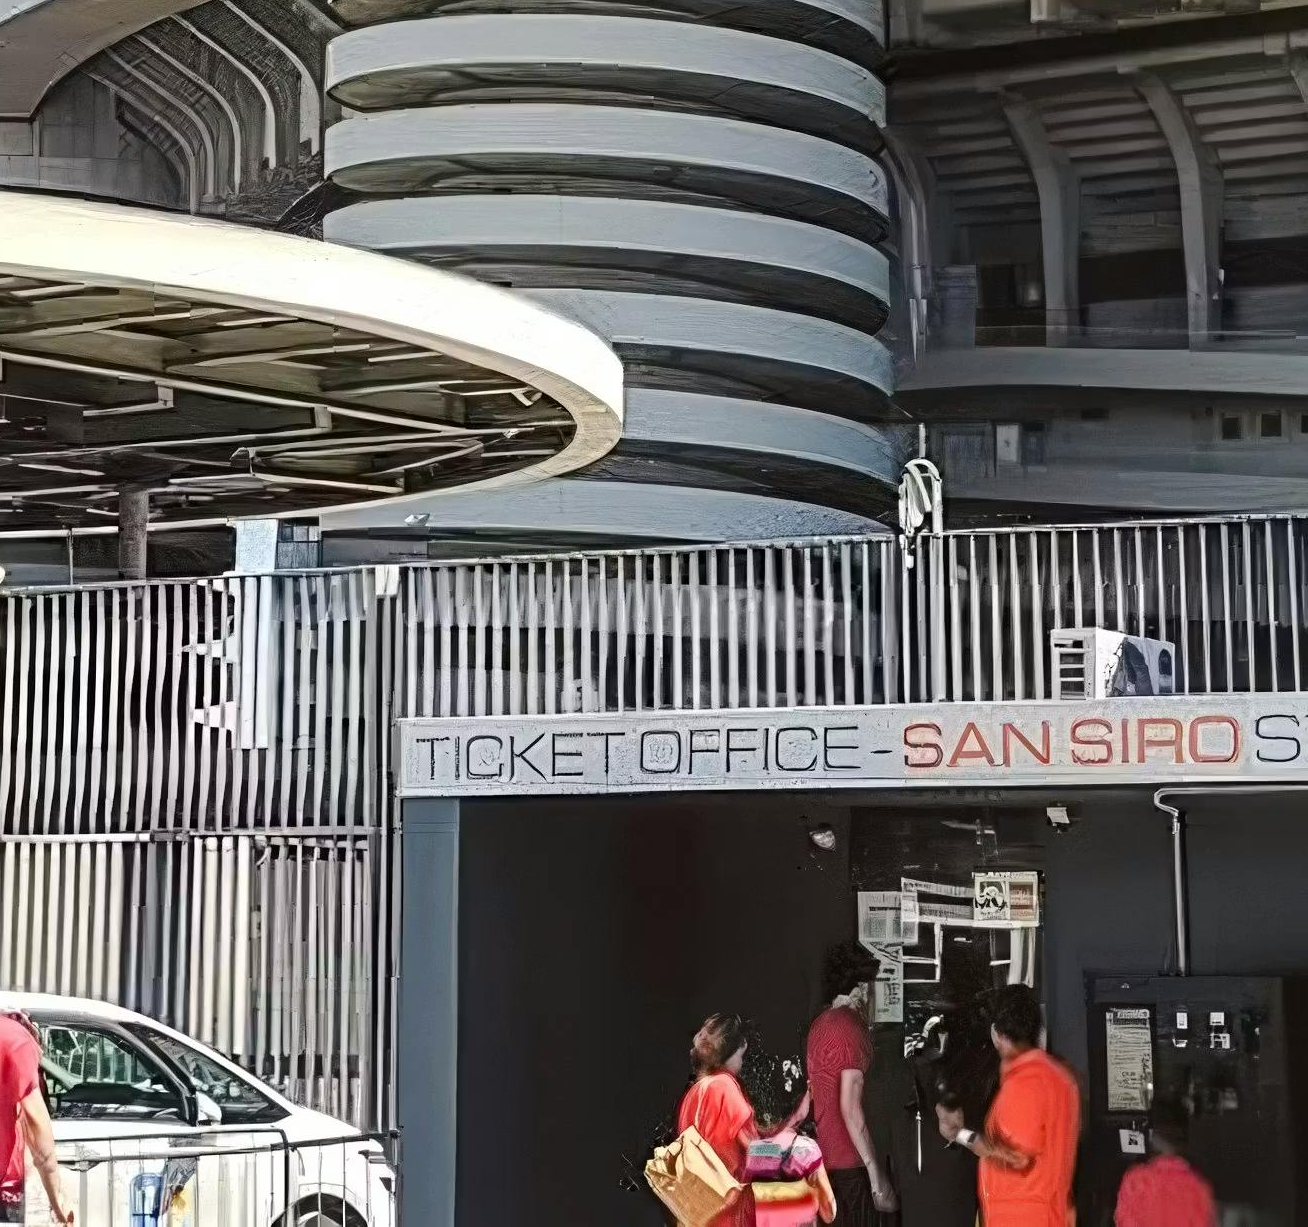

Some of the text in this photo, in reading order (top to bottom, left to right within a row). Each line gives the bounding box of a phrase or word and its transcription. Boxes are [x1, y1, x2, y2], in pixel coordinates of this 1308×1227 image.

[415, 731, 626, 783] TICKET
[639, 725, 861, 774] OFFICE
[904, 719, 1050, 768] SAN
[1070, 714, 1241, 766] SIRO
